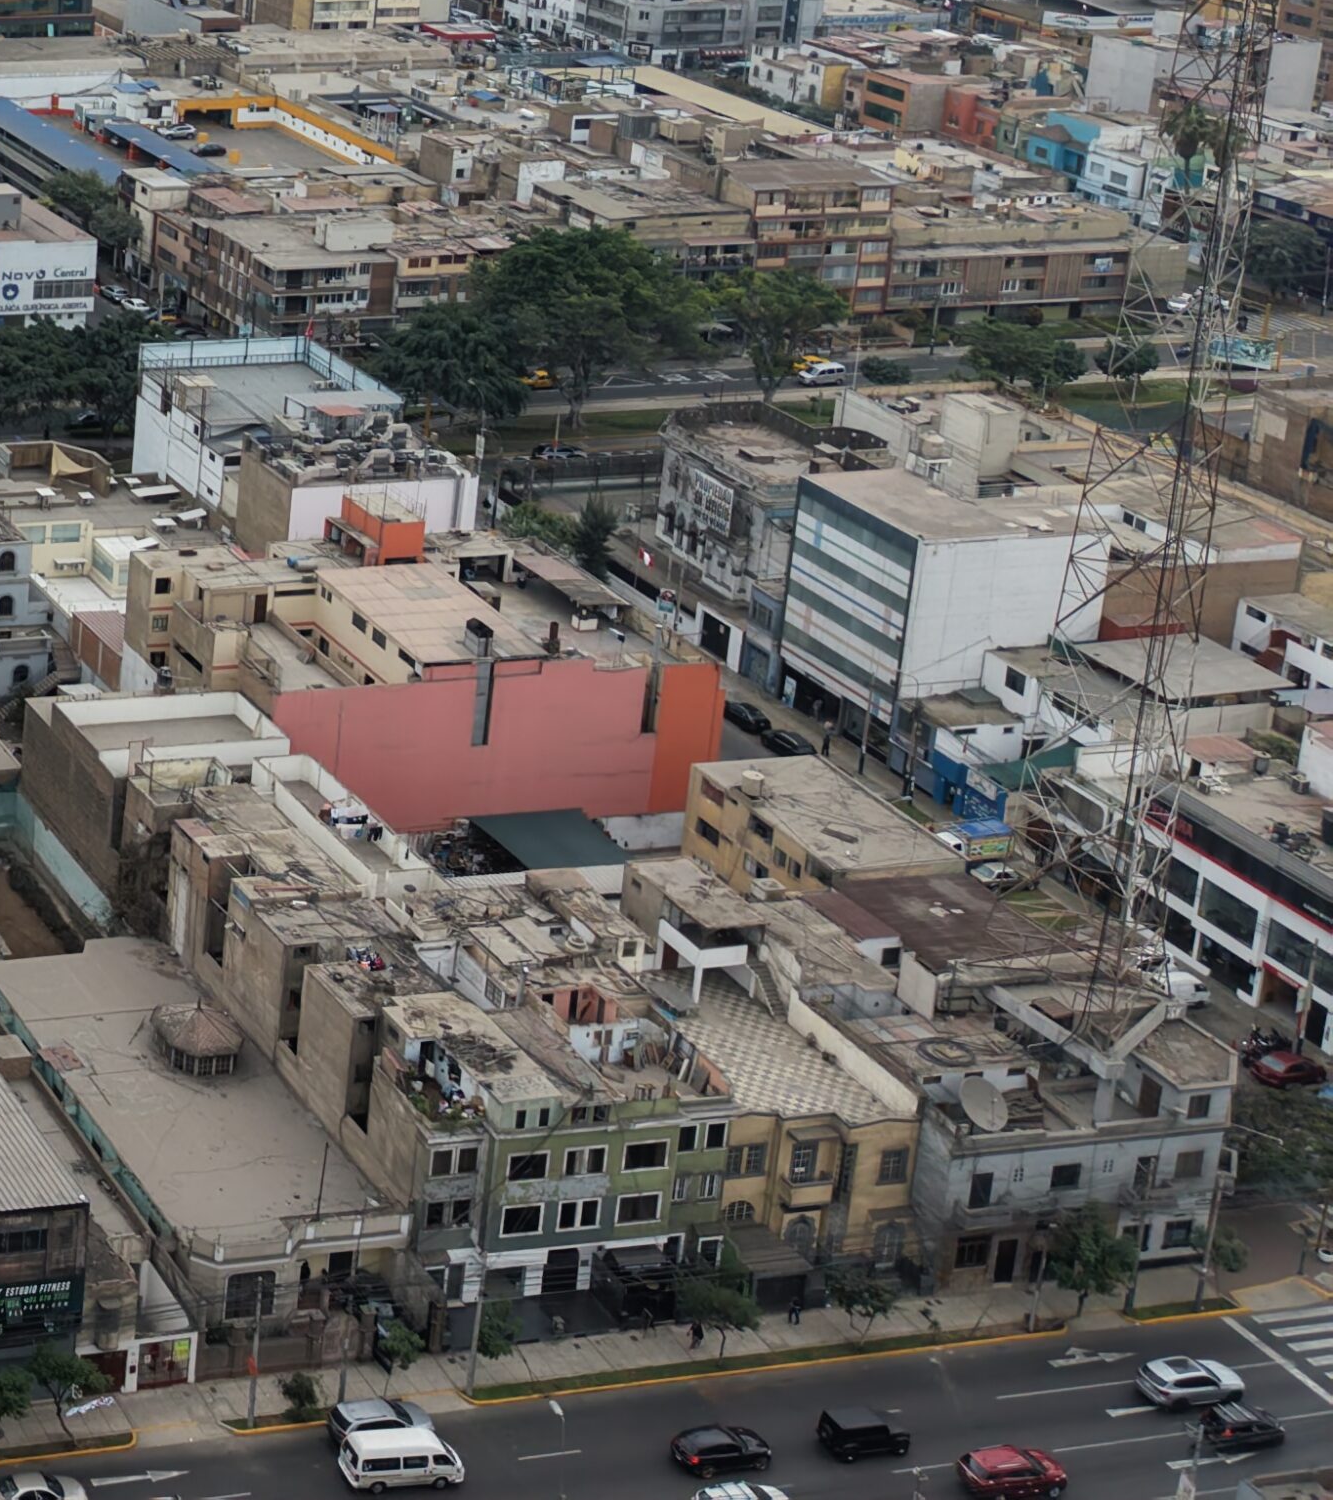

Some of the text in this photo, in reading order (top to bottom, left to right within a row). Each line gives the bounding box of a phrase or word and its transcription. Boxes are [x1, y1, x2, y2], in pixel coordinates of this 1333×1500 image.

[53, 266, 88, 278] Central
[695, 470, 733, 505] PROPIEDAD
[5, 1284, 38, 1298] ESTUDIO
[39, 1281, 72, 1294] FITNESS
